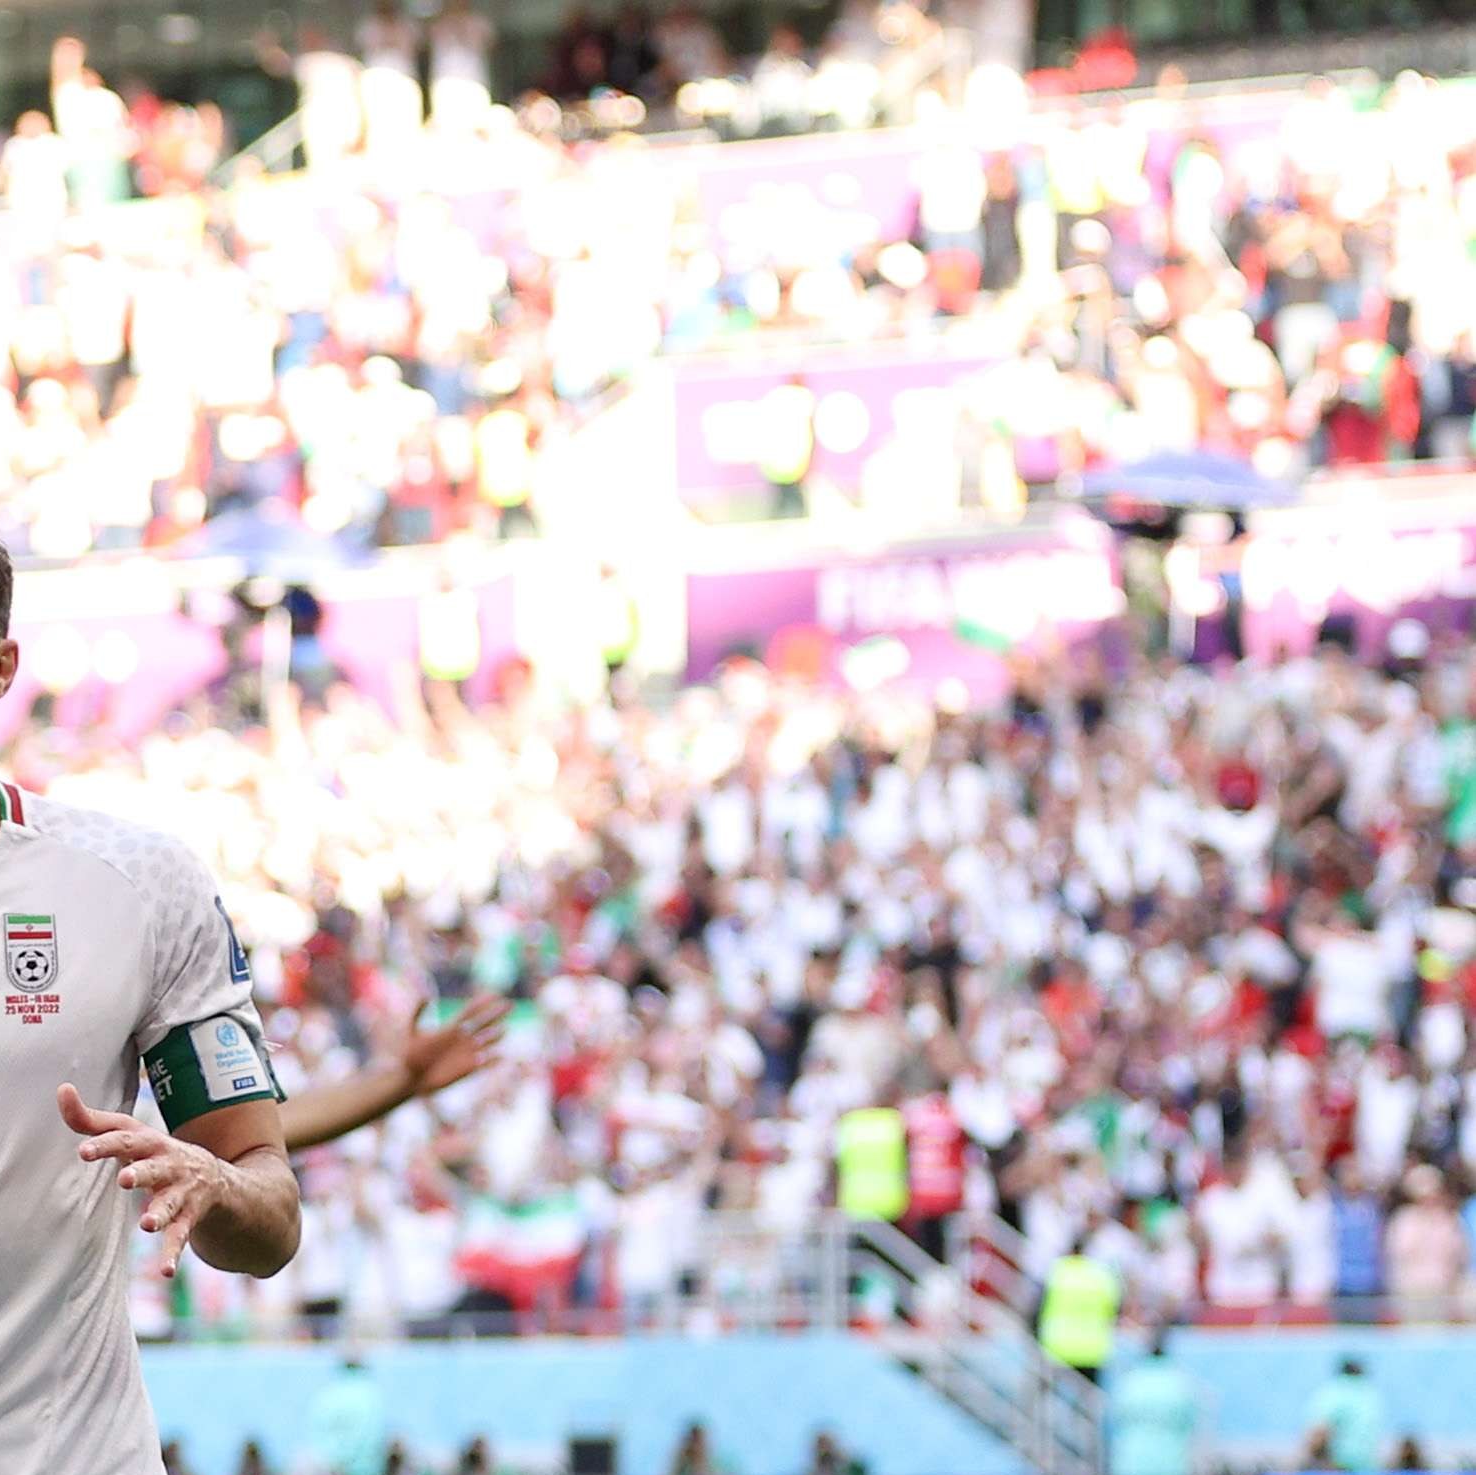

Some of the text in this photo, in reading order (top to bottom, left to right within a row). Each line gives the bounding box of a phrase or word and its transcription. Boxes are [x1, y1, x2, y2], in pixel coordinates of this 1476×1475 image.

[5, 1004, 60, 1015] 25 NOV 2022
